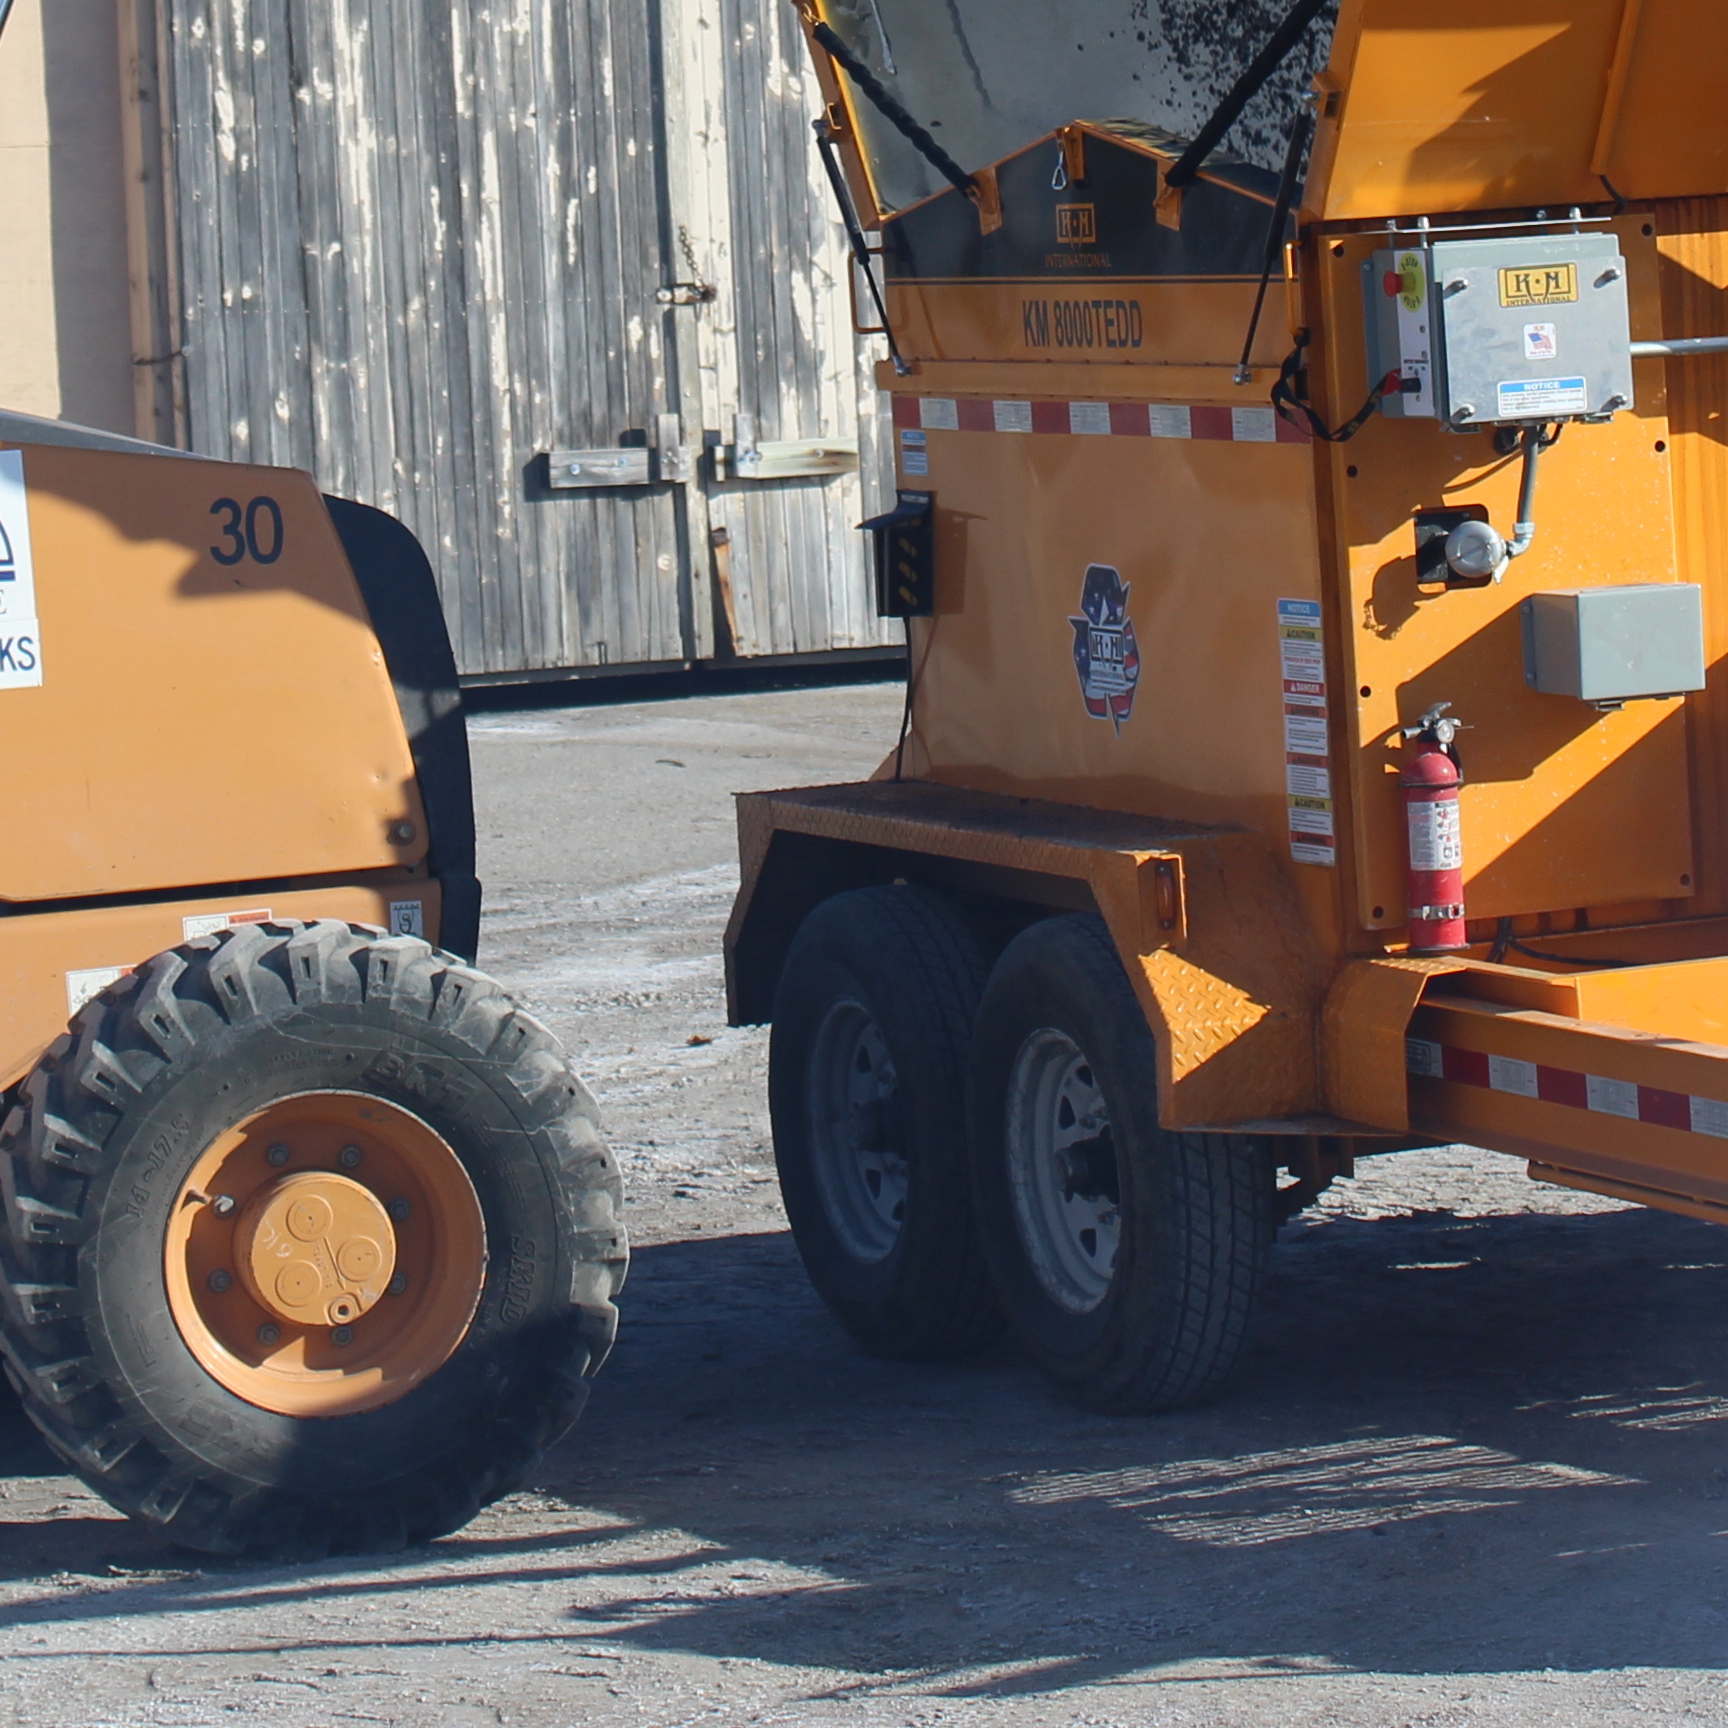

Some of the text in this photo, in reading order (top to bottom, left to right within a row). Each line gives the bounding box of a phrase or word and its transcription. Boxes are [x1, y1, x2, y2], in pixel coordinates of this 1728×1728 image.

[1506, 295, 1572, 307] INTERNATIONAL
[1022, 300, 1143, 348] KM 8000TEDD
[1524, 381, 1560, 391] NOTICE
[210, 496, 284, 566] 30
